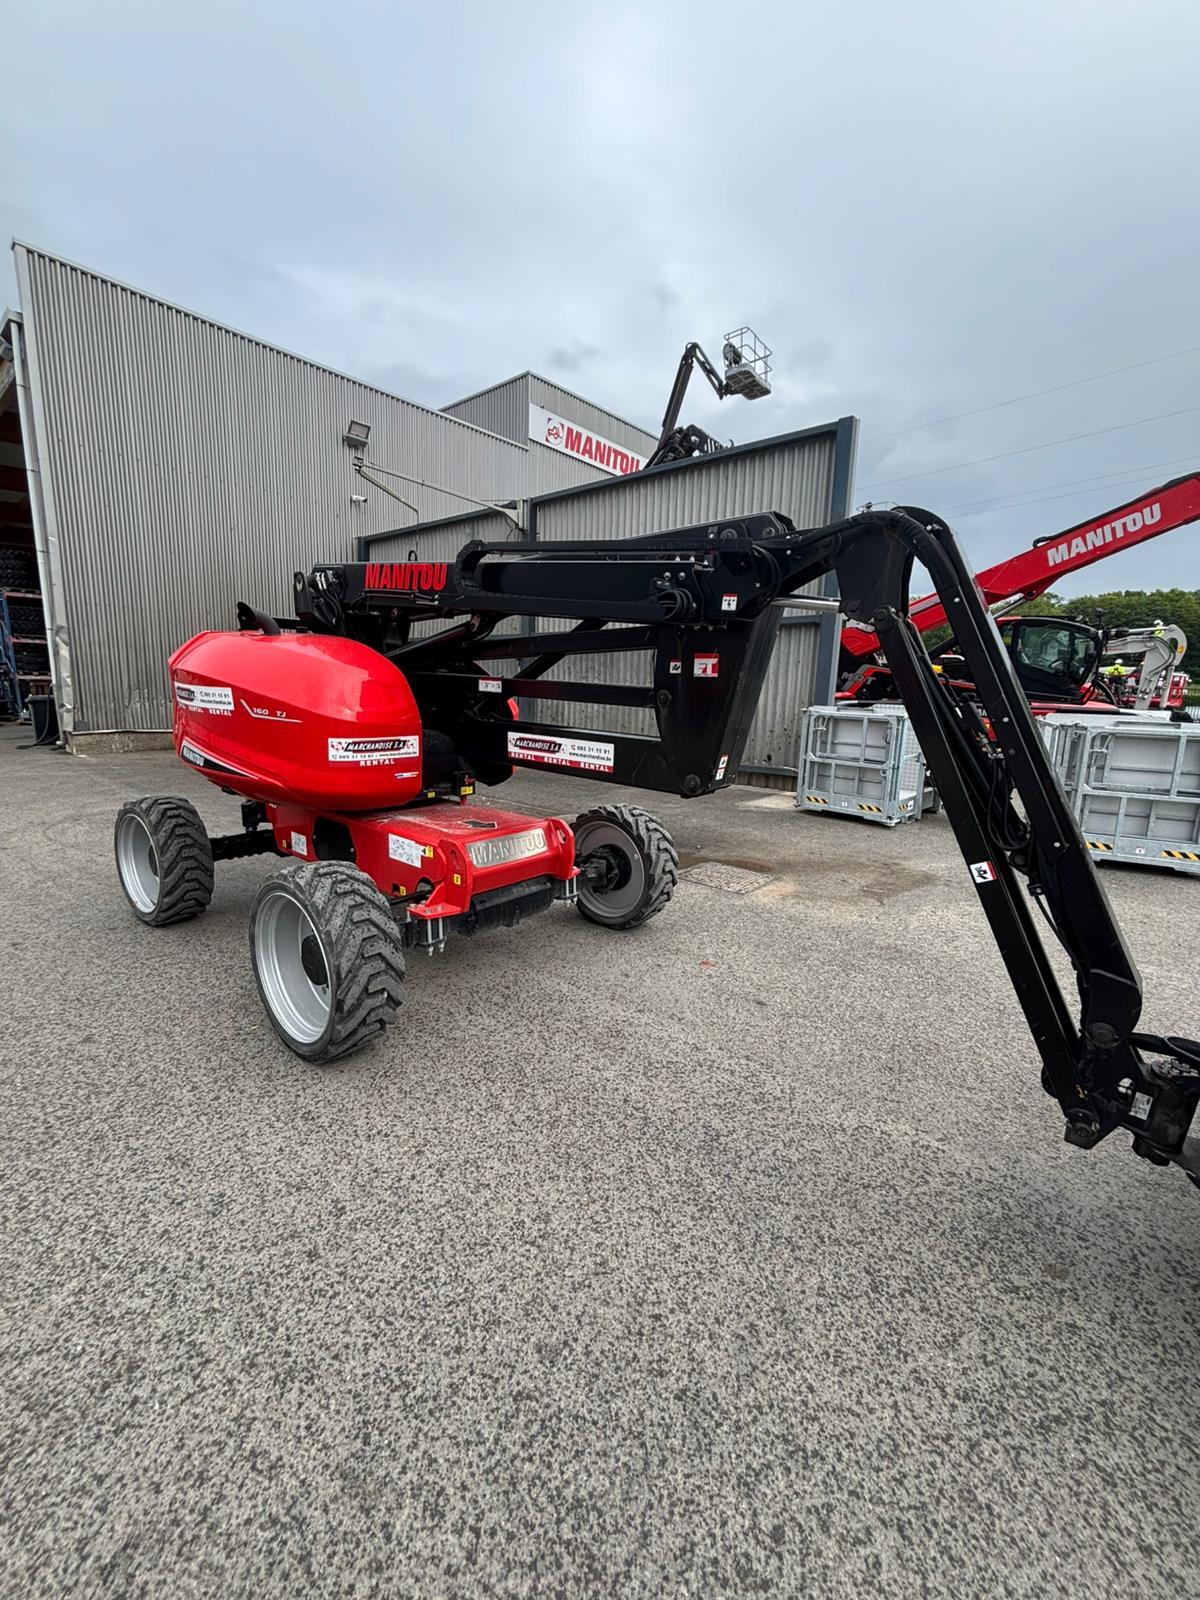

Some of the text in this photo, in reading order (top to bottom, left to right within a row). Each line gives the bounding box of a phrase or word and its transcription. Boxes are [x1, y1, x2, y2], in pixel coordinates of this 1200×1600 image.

[565, 426, 640, 475] MANITOU
[1047, 502, 1161, 567] MANITOU
[365, 563, 447, 590] MANITOU
[209, 708, 232, 716] RENTAL
[253, 707, 287, 718] 160 TJ
[347, 742, 393, 751] MARCHANDISE
[516, 740, 550, 750] MARCHANDISE
[183, 746, 205, 766] MANITOU
[511, 752, 609, 772] RENTAL RENTAL RENTAL
[471, 831, 547, 865] MANITOU
